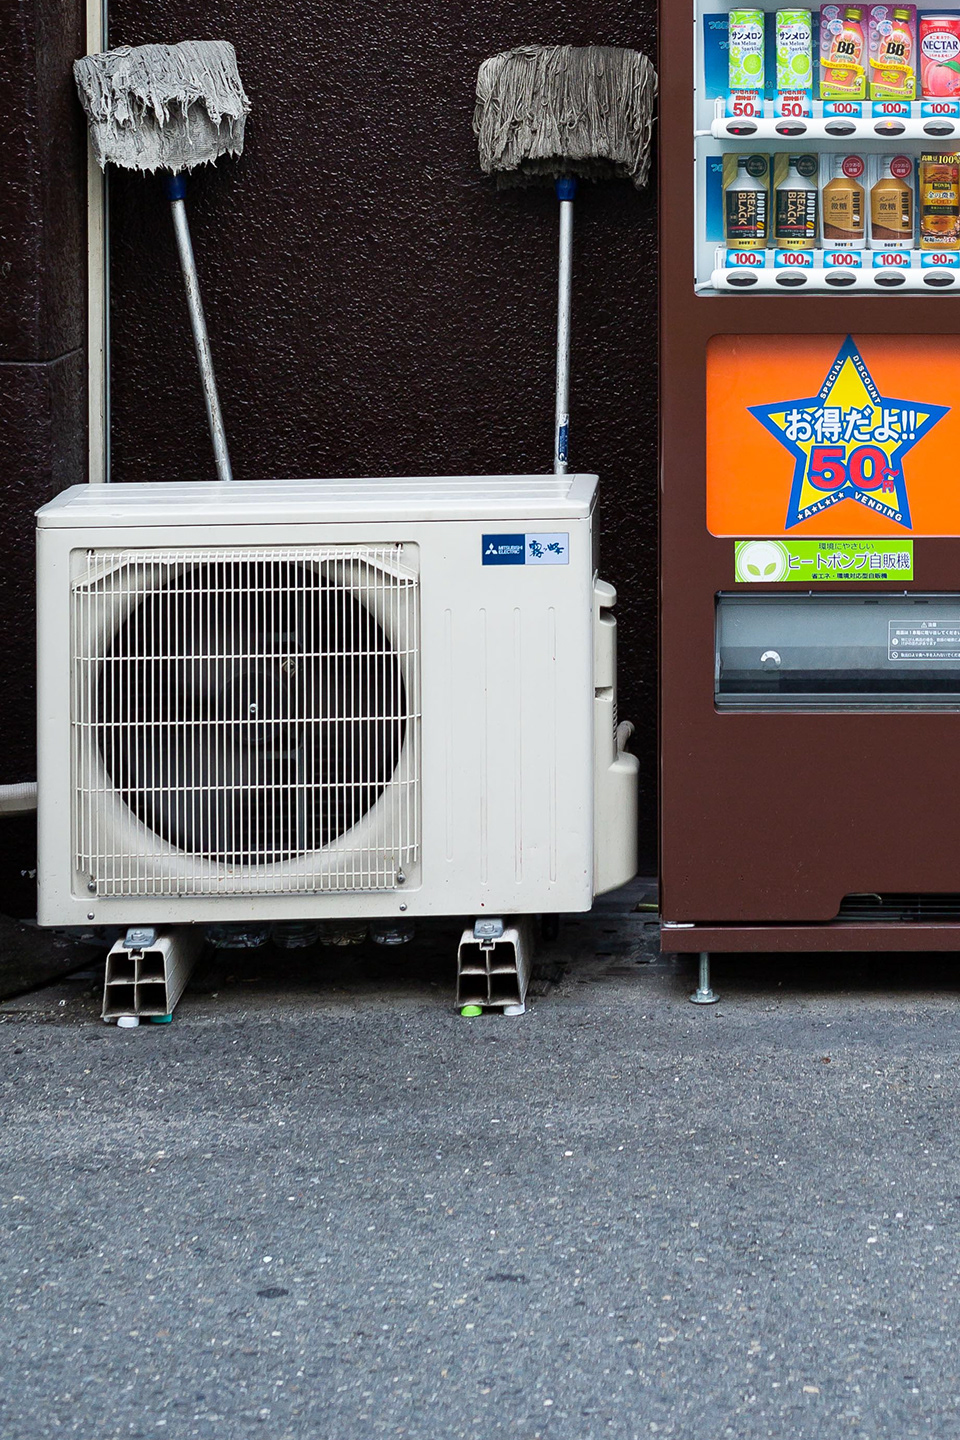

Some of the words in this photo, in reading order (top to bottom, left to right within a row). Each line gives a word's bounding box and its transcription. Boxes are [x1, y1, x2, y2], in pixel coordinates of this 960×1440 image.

[732, 32, 762, 40] サンメロン
[780, 32, 810, 40] サンメロン
[836, 40, 855, 55] BB
[923, 40, 958, 50] NECTAR
[886, 42, 904, 56] BB
[738, 192, 747, 225] BLACK
[747, 192, 755, 217] REAL
[756, 192, 765, 237] DOUTOR
[788, 192, 796, 224] BLACK
[797, 192, 806, 217] REAL
[806, 192, 816, 237] DOUTOR
[819, 358, 844, 400] SPECIAL
[852, 354, 882, 404] DISCOUNT
[854, 491, 903, 522] VENDING
[788, 552, 910, 570] ヒートポンプ自販機
